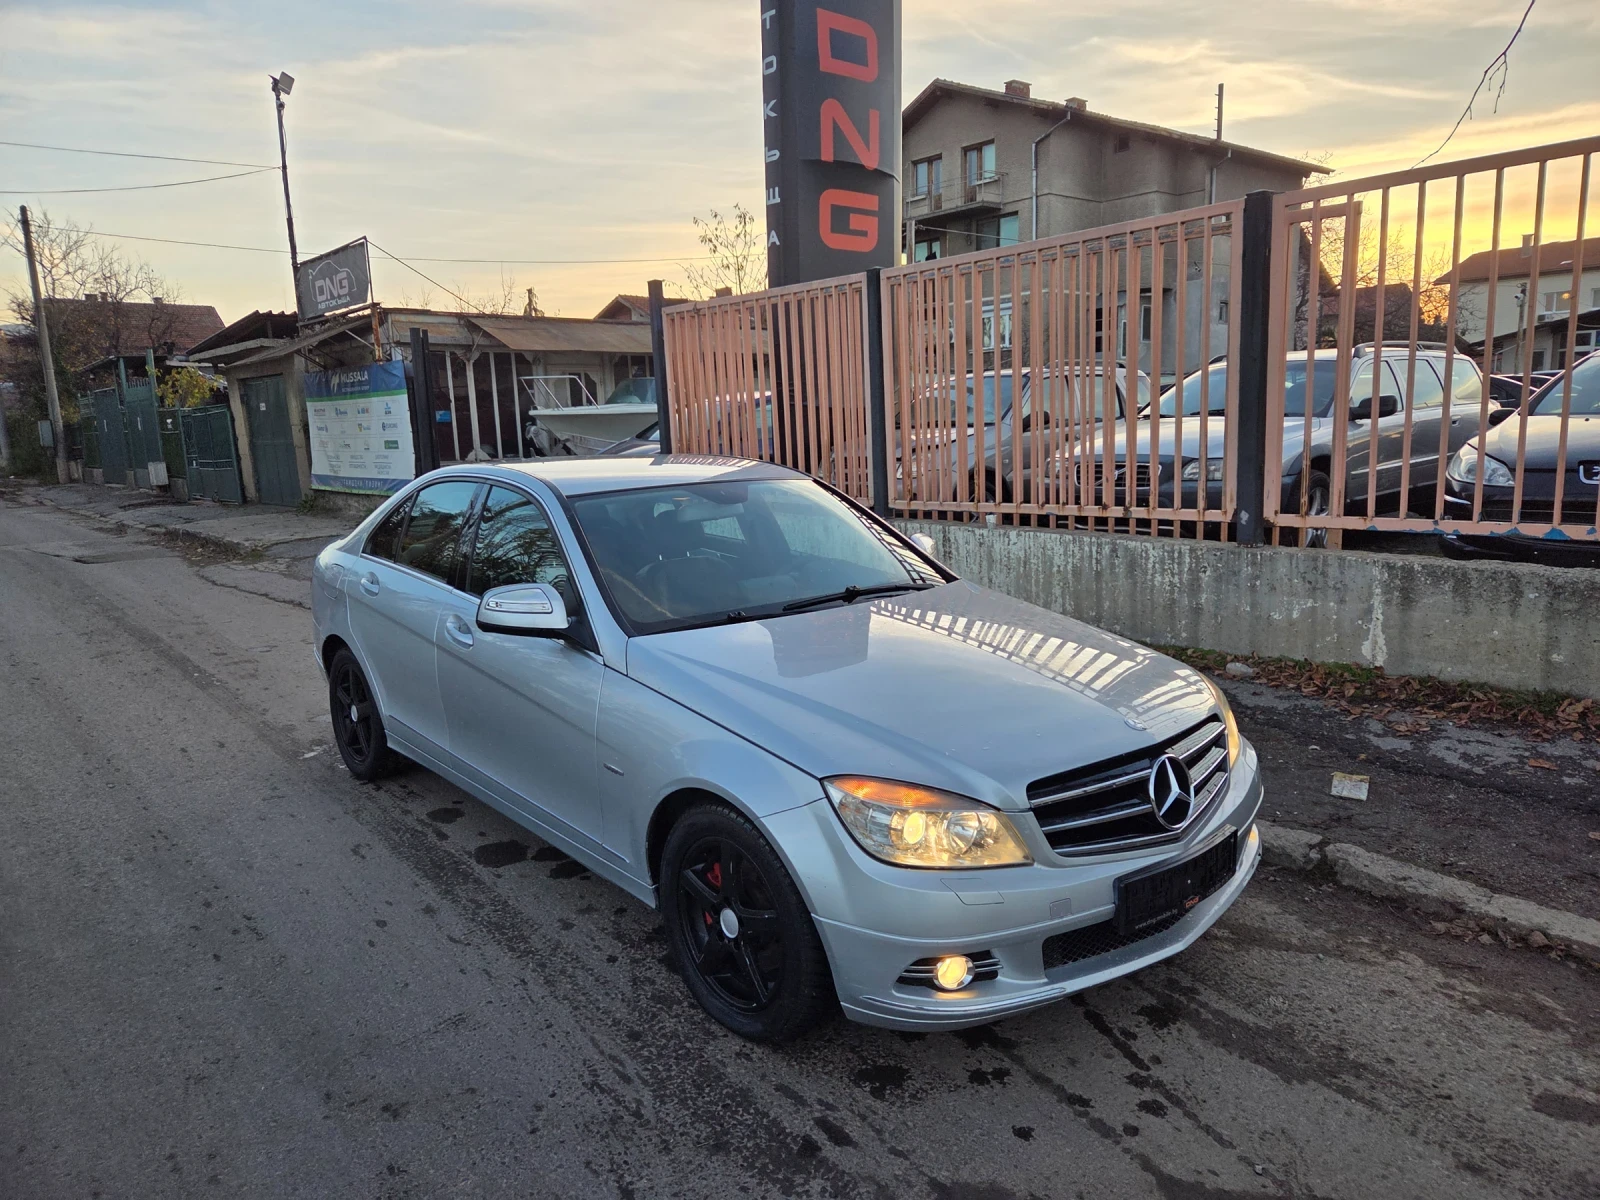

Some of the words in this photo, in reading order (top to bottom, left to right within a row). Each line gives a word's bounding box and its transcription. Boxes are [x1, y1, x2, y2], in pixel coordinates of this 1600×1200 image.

[817, 7, 880, 252] DNG
[315, 272, 349, 303] DNG
[340, 370, 369, 383] MUSSALA
[1185, 896, 1200, 909] DNG
